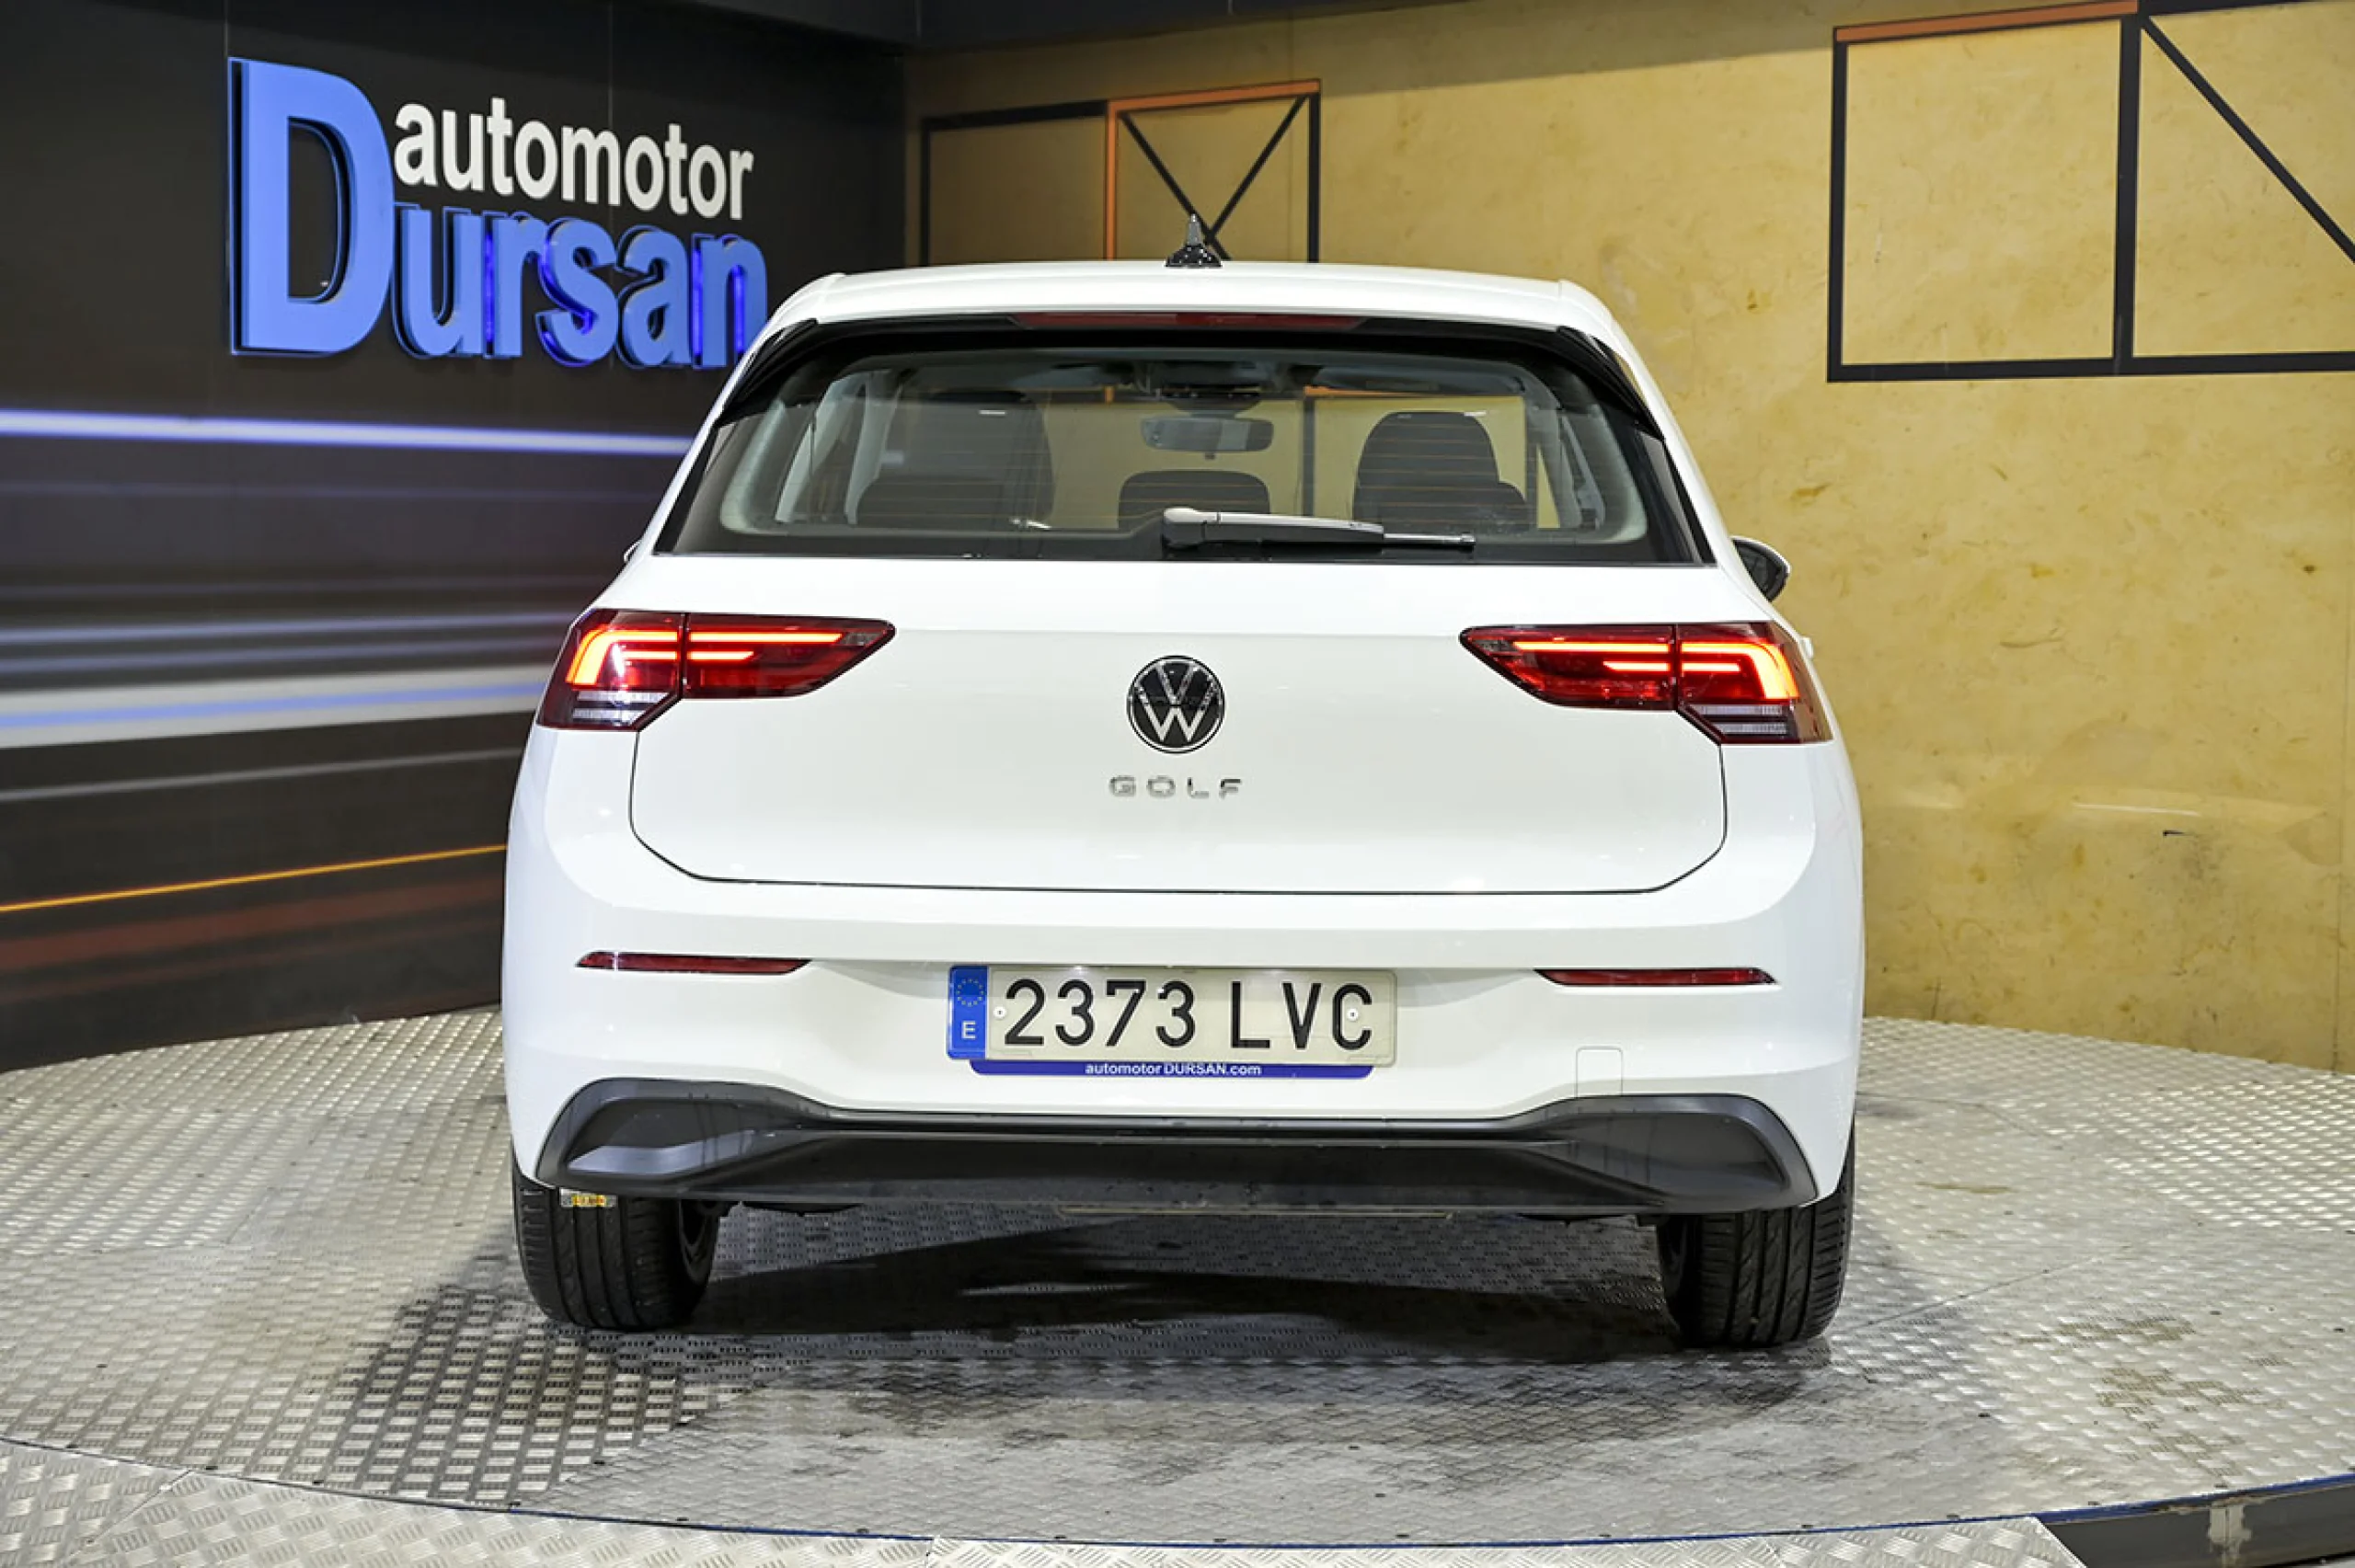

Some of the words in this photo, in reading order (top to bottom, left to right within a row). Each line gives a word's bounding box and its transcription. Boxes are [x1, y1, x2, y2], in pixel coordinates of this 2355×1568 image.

[394, 97, 754, 221] automotor
[228, 57, 769, 369] Dursan
[1109, 774, 1243, 800] GOLF
[961, 1020, 977, 1040] E
[1004, 979, 1197, 1048] 2373
[1231, 980, 1373, 1050] LVC
